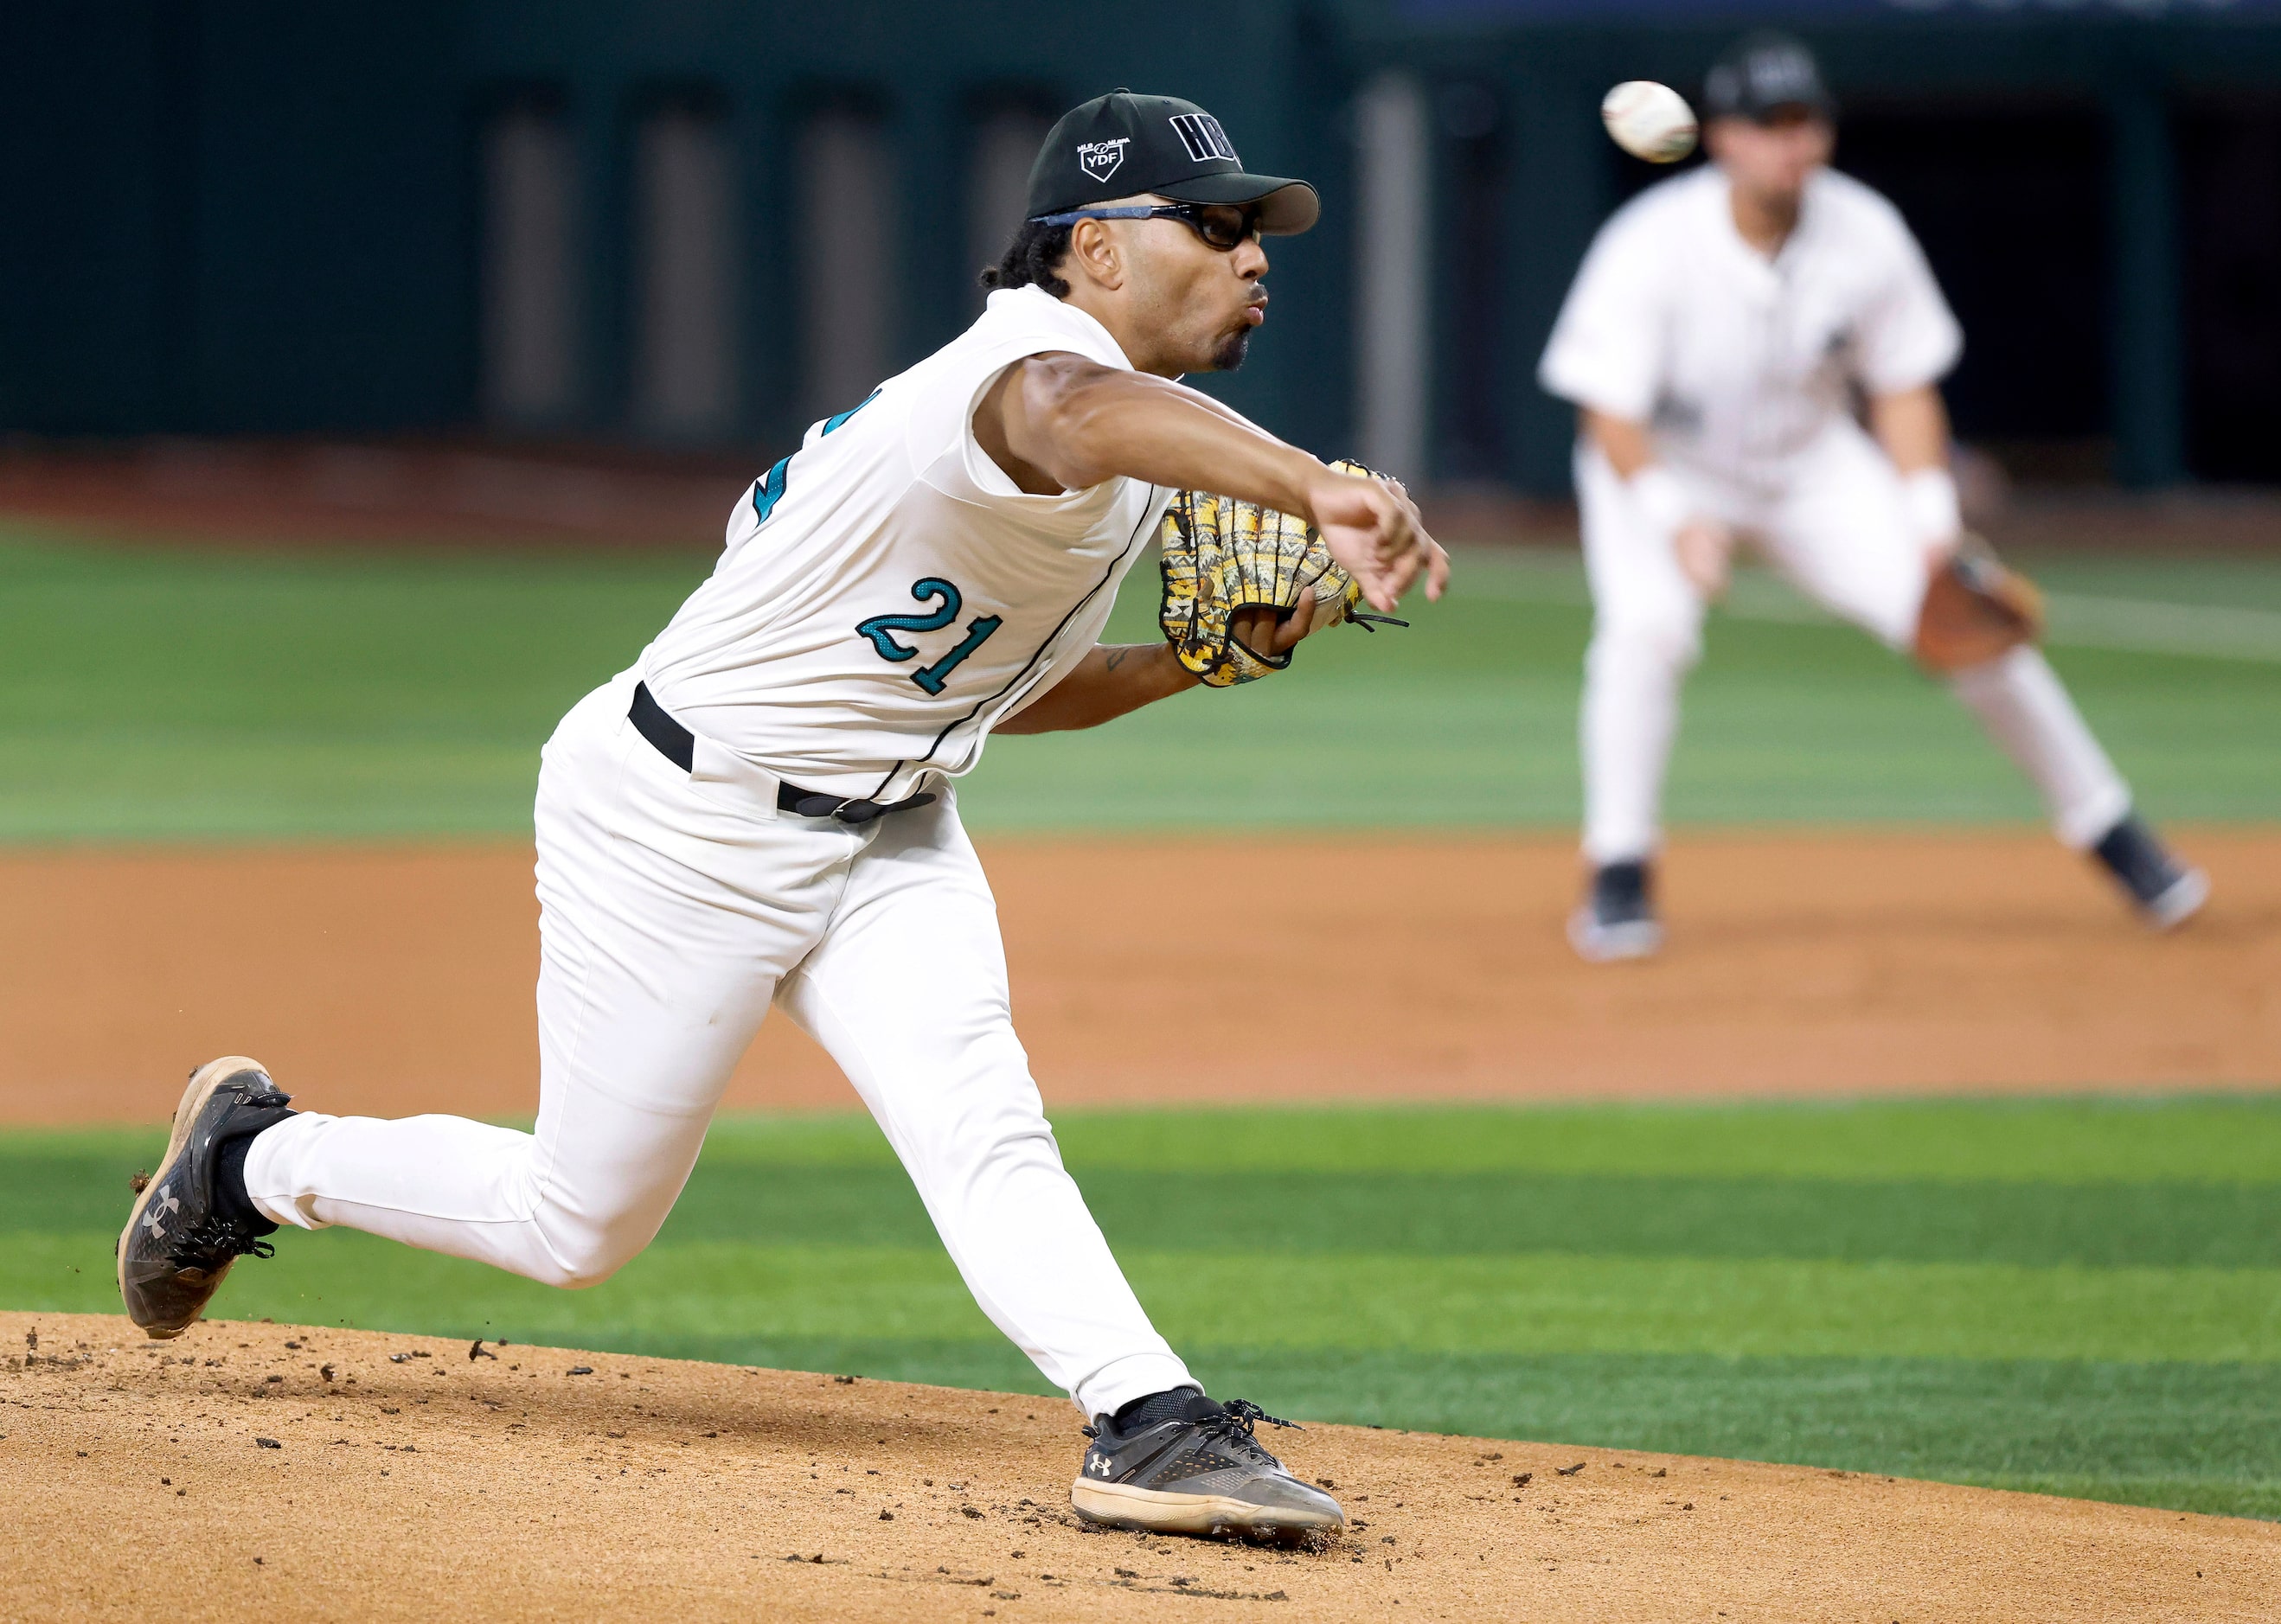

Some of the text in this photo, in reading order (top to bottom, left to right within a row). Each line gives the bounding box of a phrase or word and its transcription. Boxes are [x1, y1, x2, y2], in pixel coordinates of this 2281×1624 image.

[1077, 142, 1093, 153] MLB
[1169, 113, 1243, 169] HB
[1086, 152, 1118, 168] YDF
[855, 577, 1003, 697] 21
